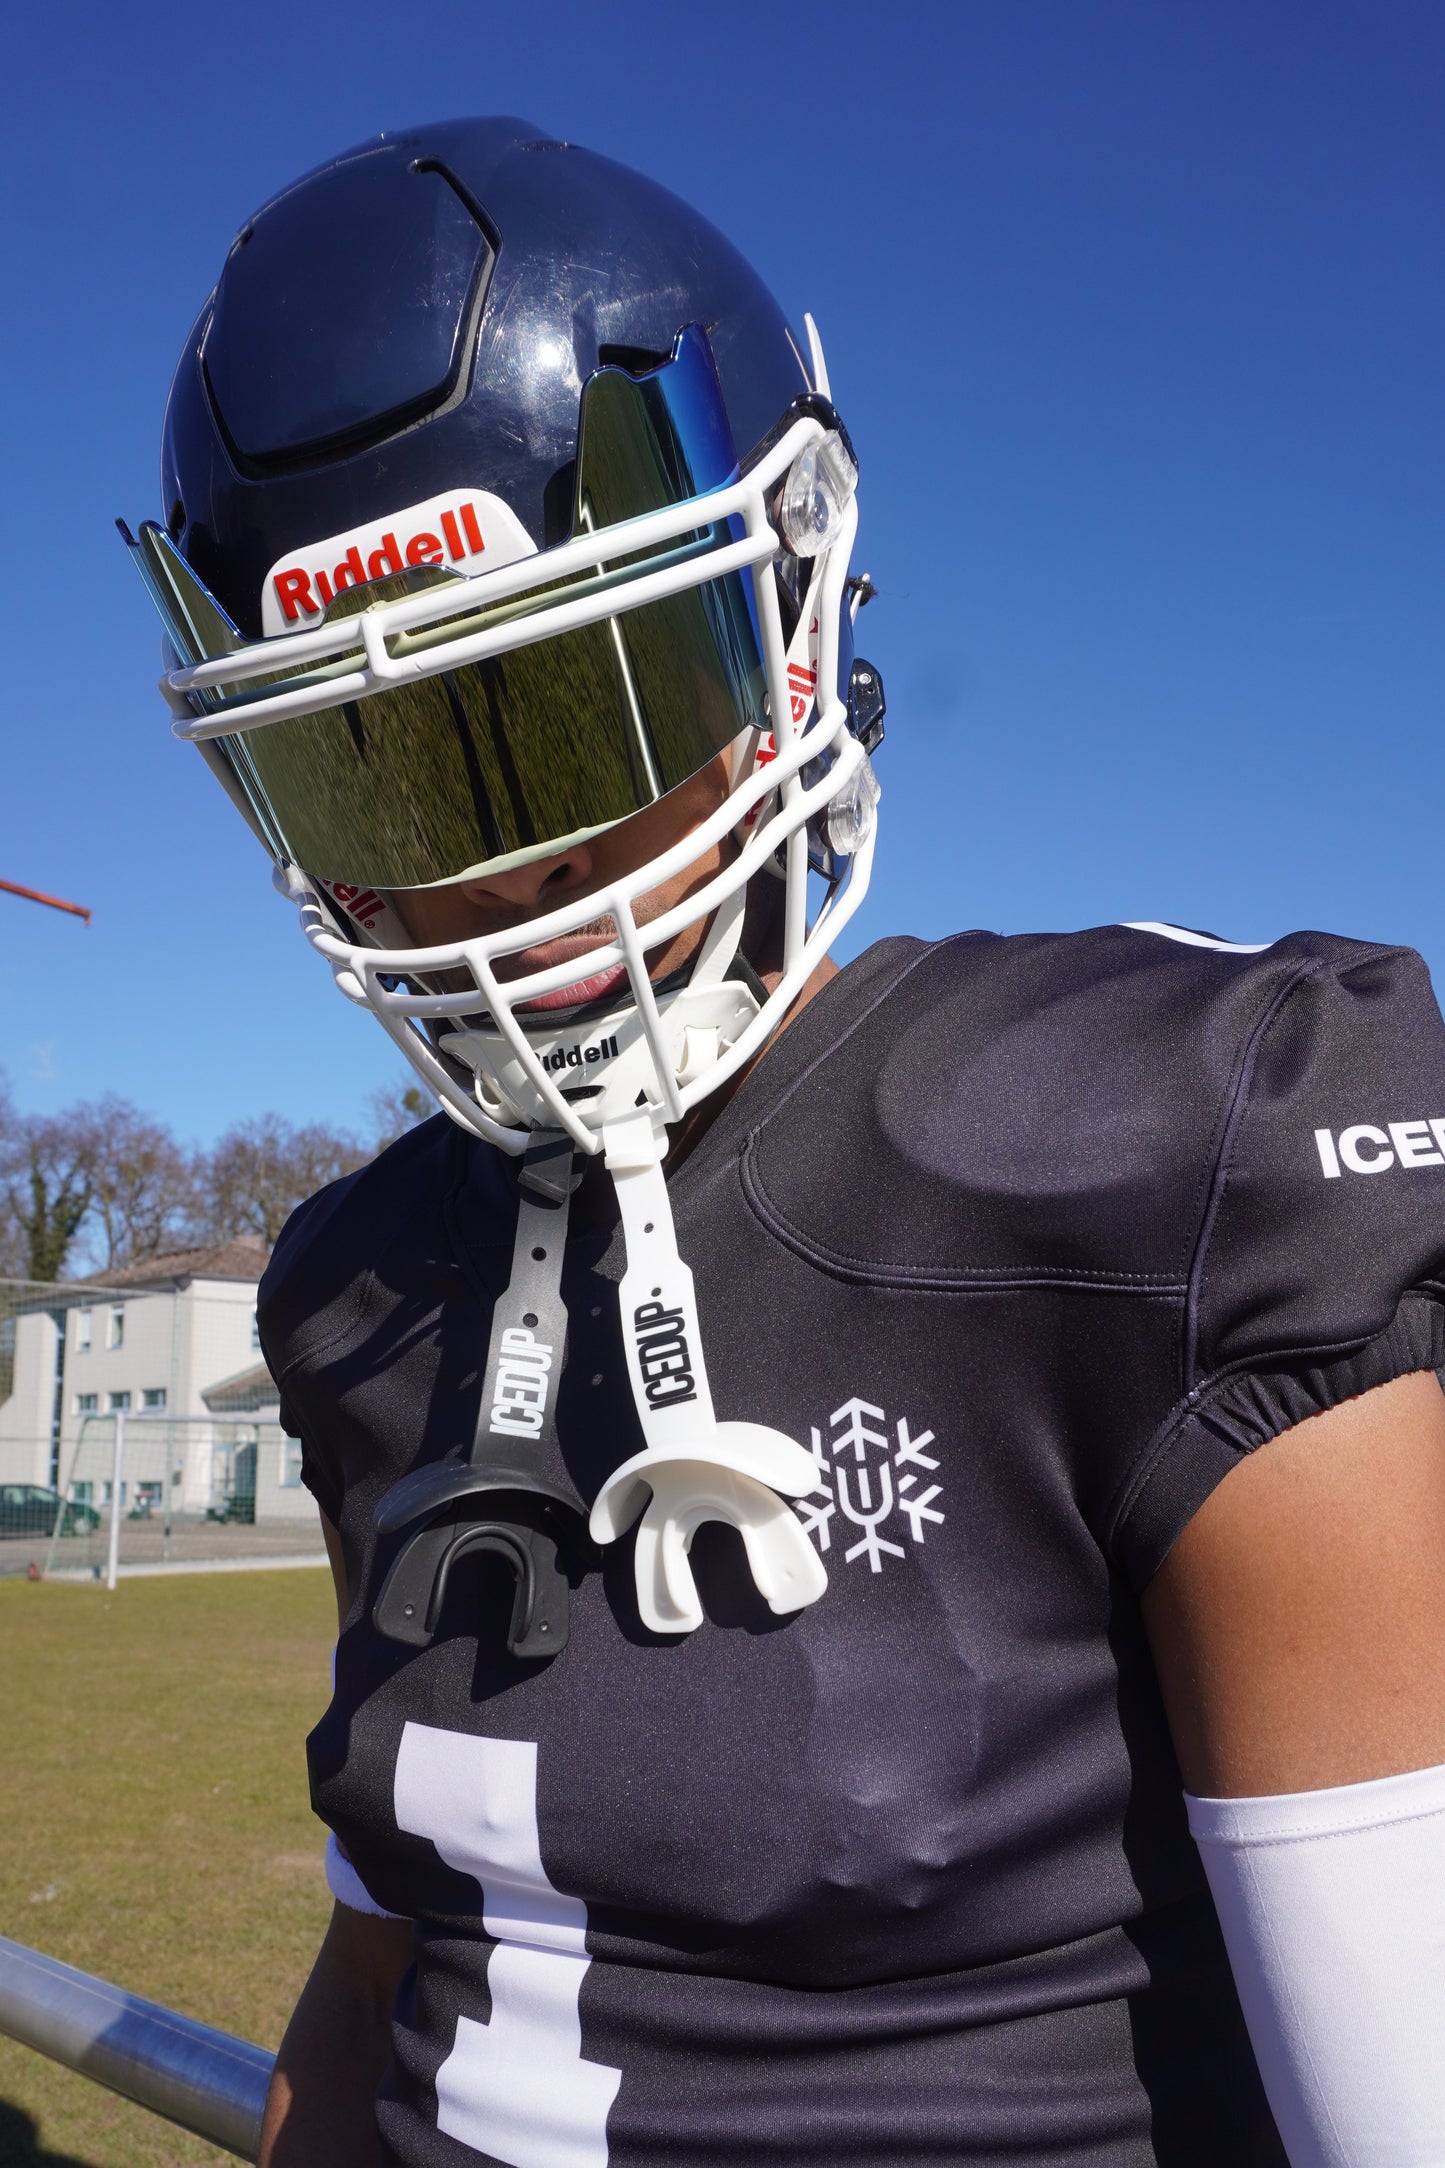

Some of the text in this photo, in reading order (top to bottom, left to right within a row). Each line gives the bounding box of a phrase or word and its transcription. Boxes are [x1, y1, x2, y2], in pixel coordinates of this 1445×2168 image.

[274, 503, 485, 620] Riddell
[535, 1035, 619, 1071] iddell
[489, 1328, 553, 1440] ICEDUP
[634, 1301, 698, 1411] ICEDUP
[394, 1720, 622, 2168] 1
